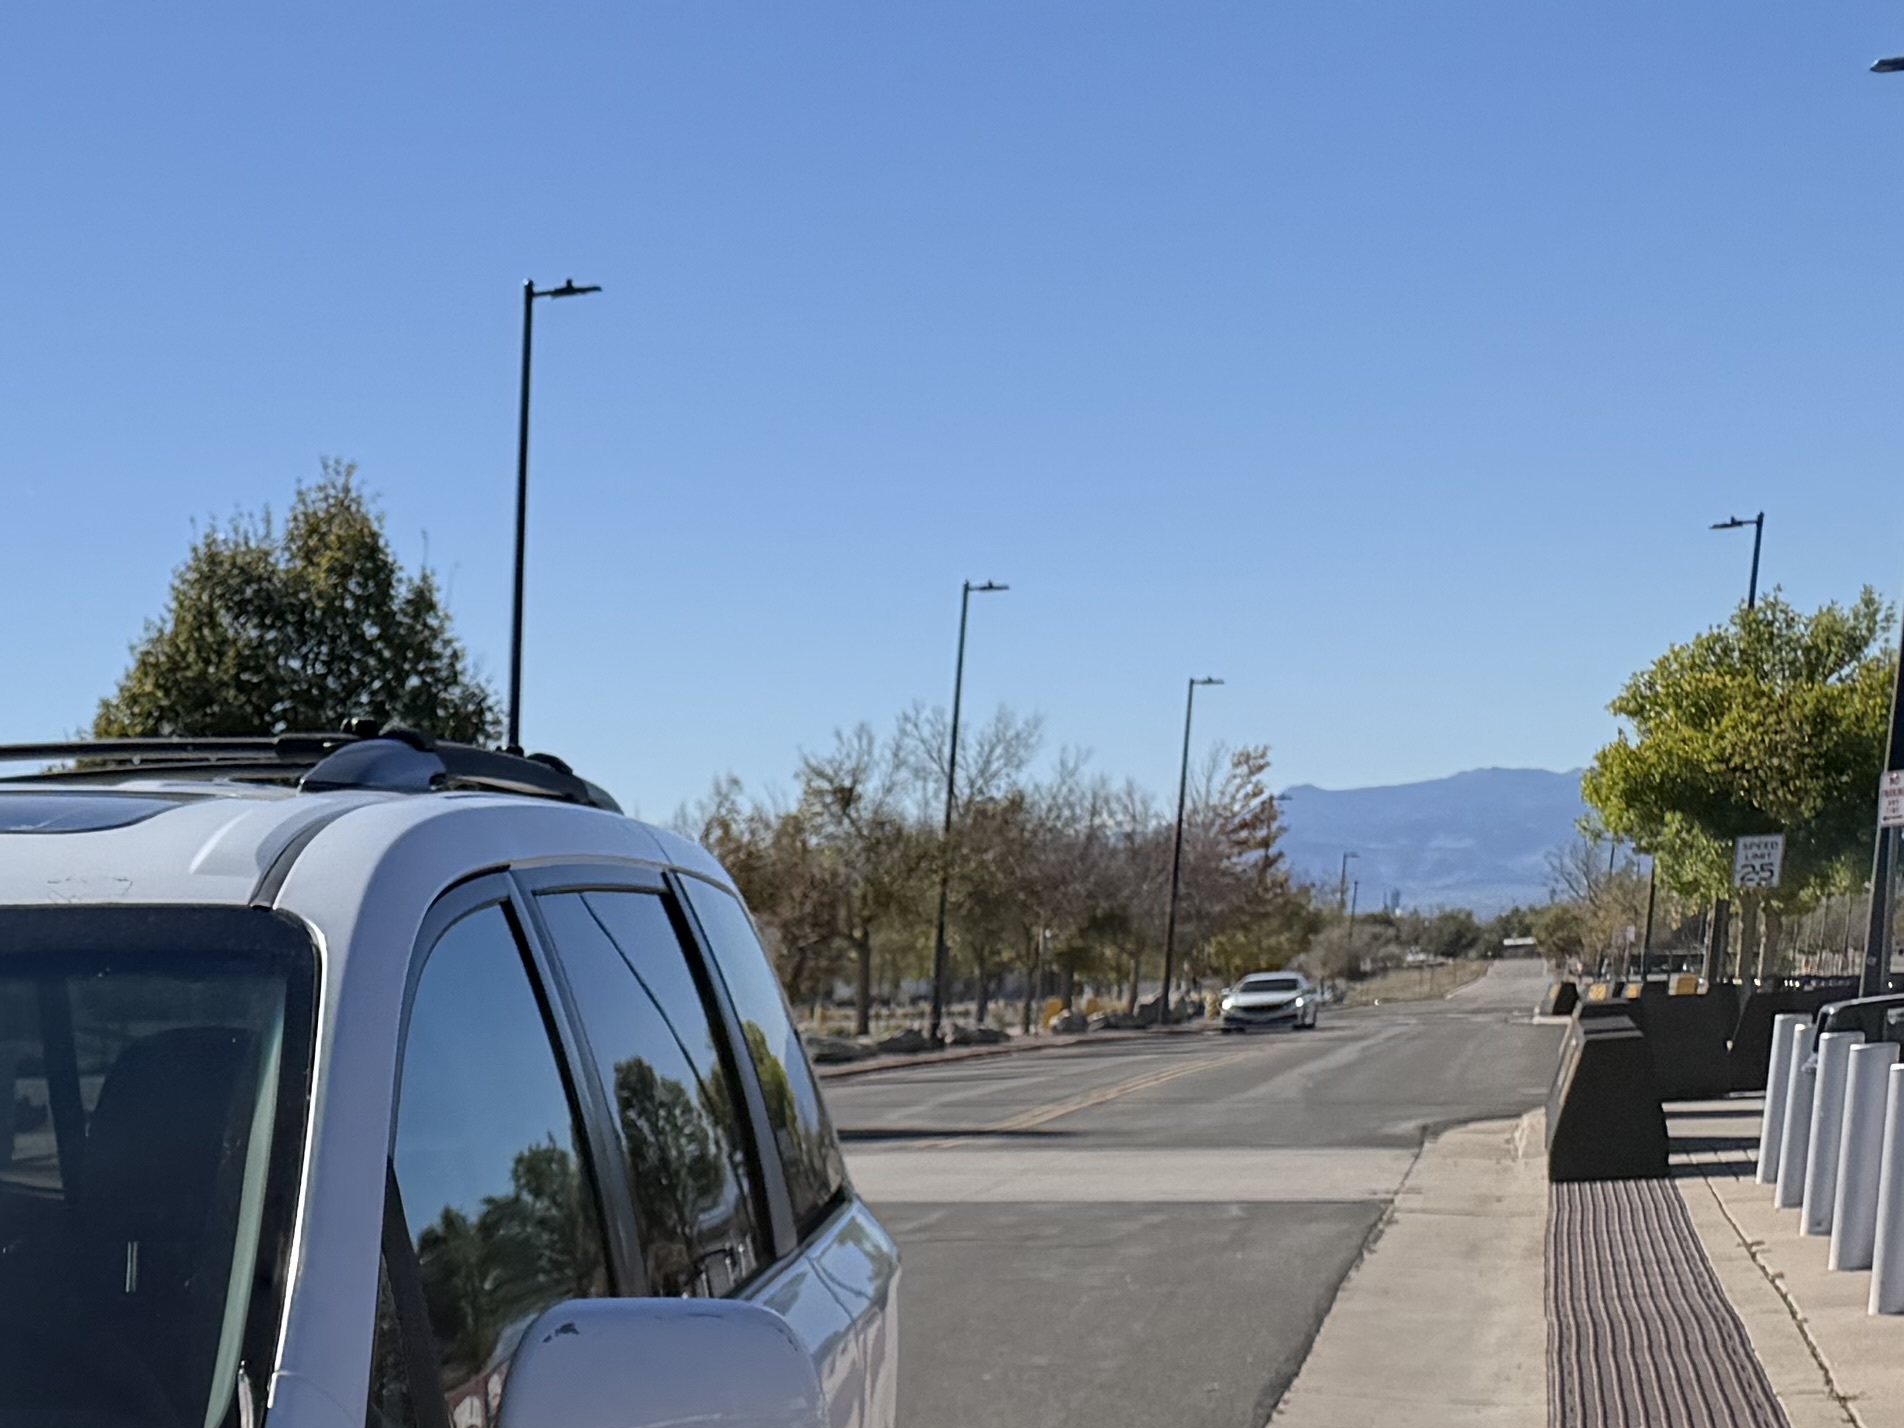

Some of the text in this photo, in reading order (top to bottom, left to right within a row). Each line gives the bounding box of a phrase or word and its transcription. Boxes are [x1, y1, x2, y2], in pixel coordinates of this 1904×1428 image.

[1742, 841, 1778, 850] SPEED
[1744, 852, 1771, 861] LIMIT
[1740, 862, 1774, 883] 25
